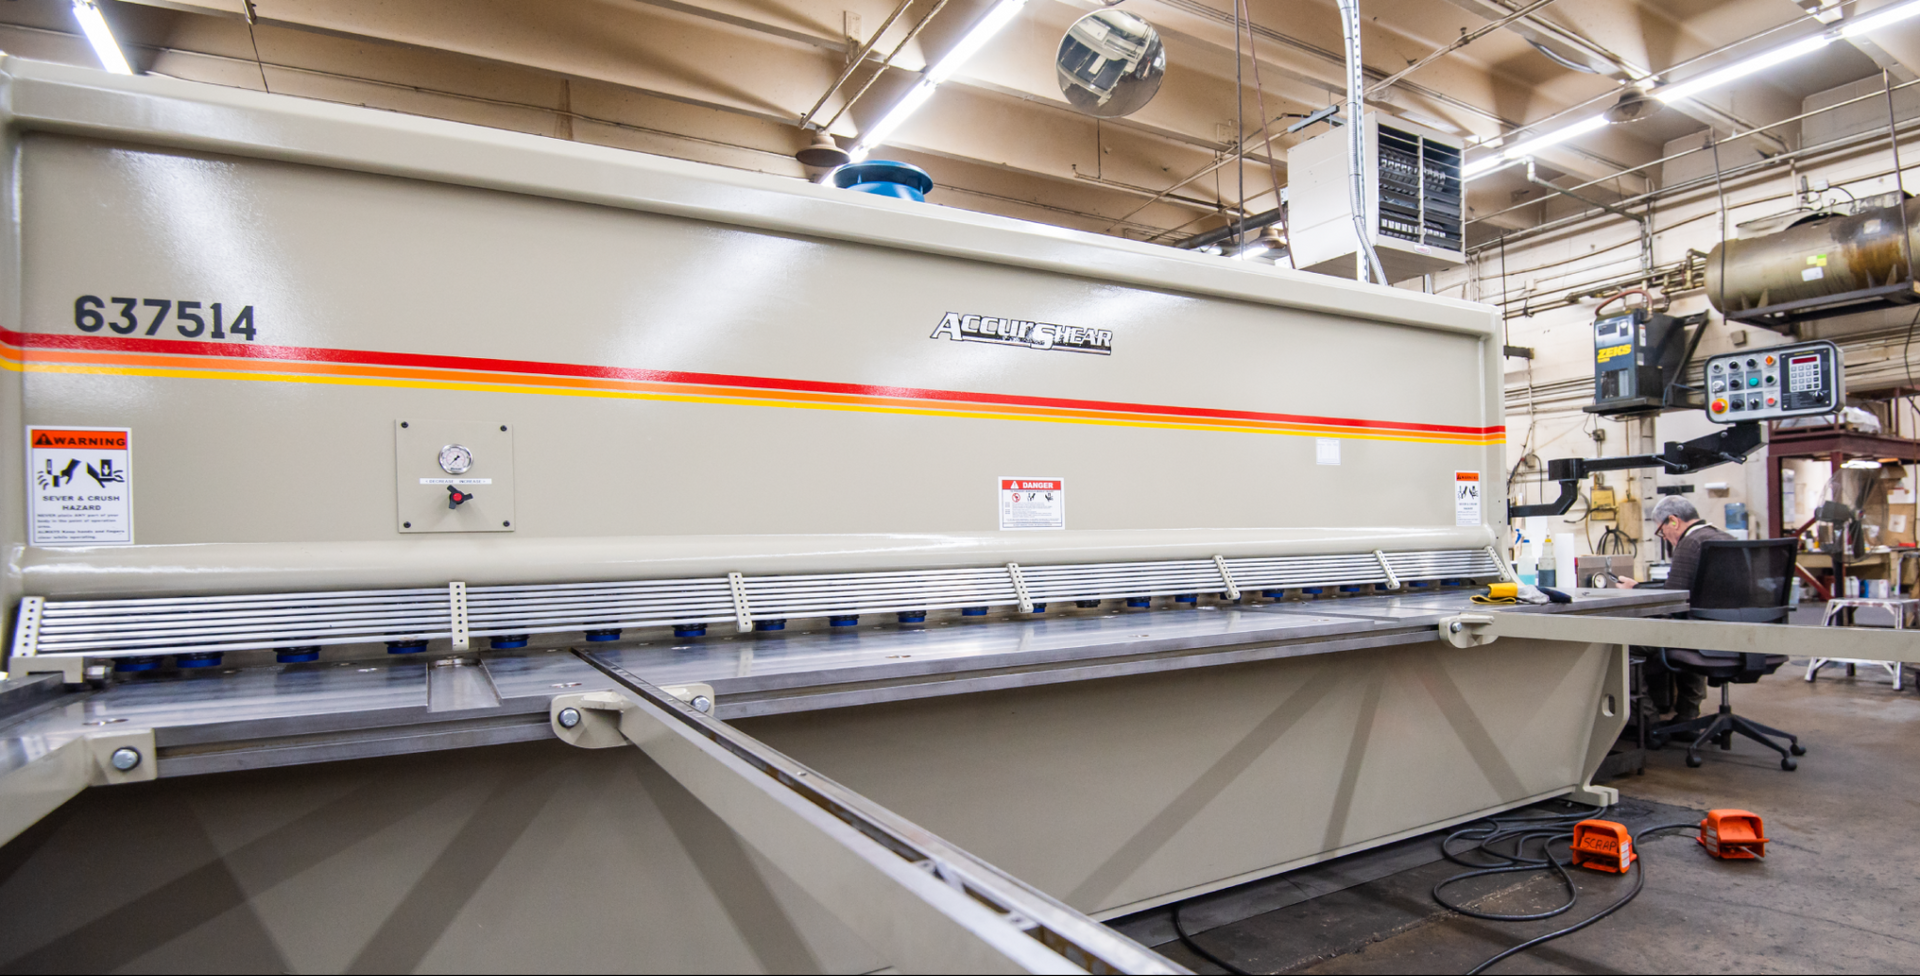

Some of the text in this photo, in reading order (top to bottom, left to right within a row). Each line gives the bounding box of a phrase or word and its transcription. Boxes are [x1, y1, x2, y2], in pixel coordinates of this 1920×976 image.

[74, 295, 257, 341] 637514
[1597, 344, 1632, 358] ZEKS
[53, 437, 126, 446] WARNING
[1582, 837, 1617, 851] SCRAP
